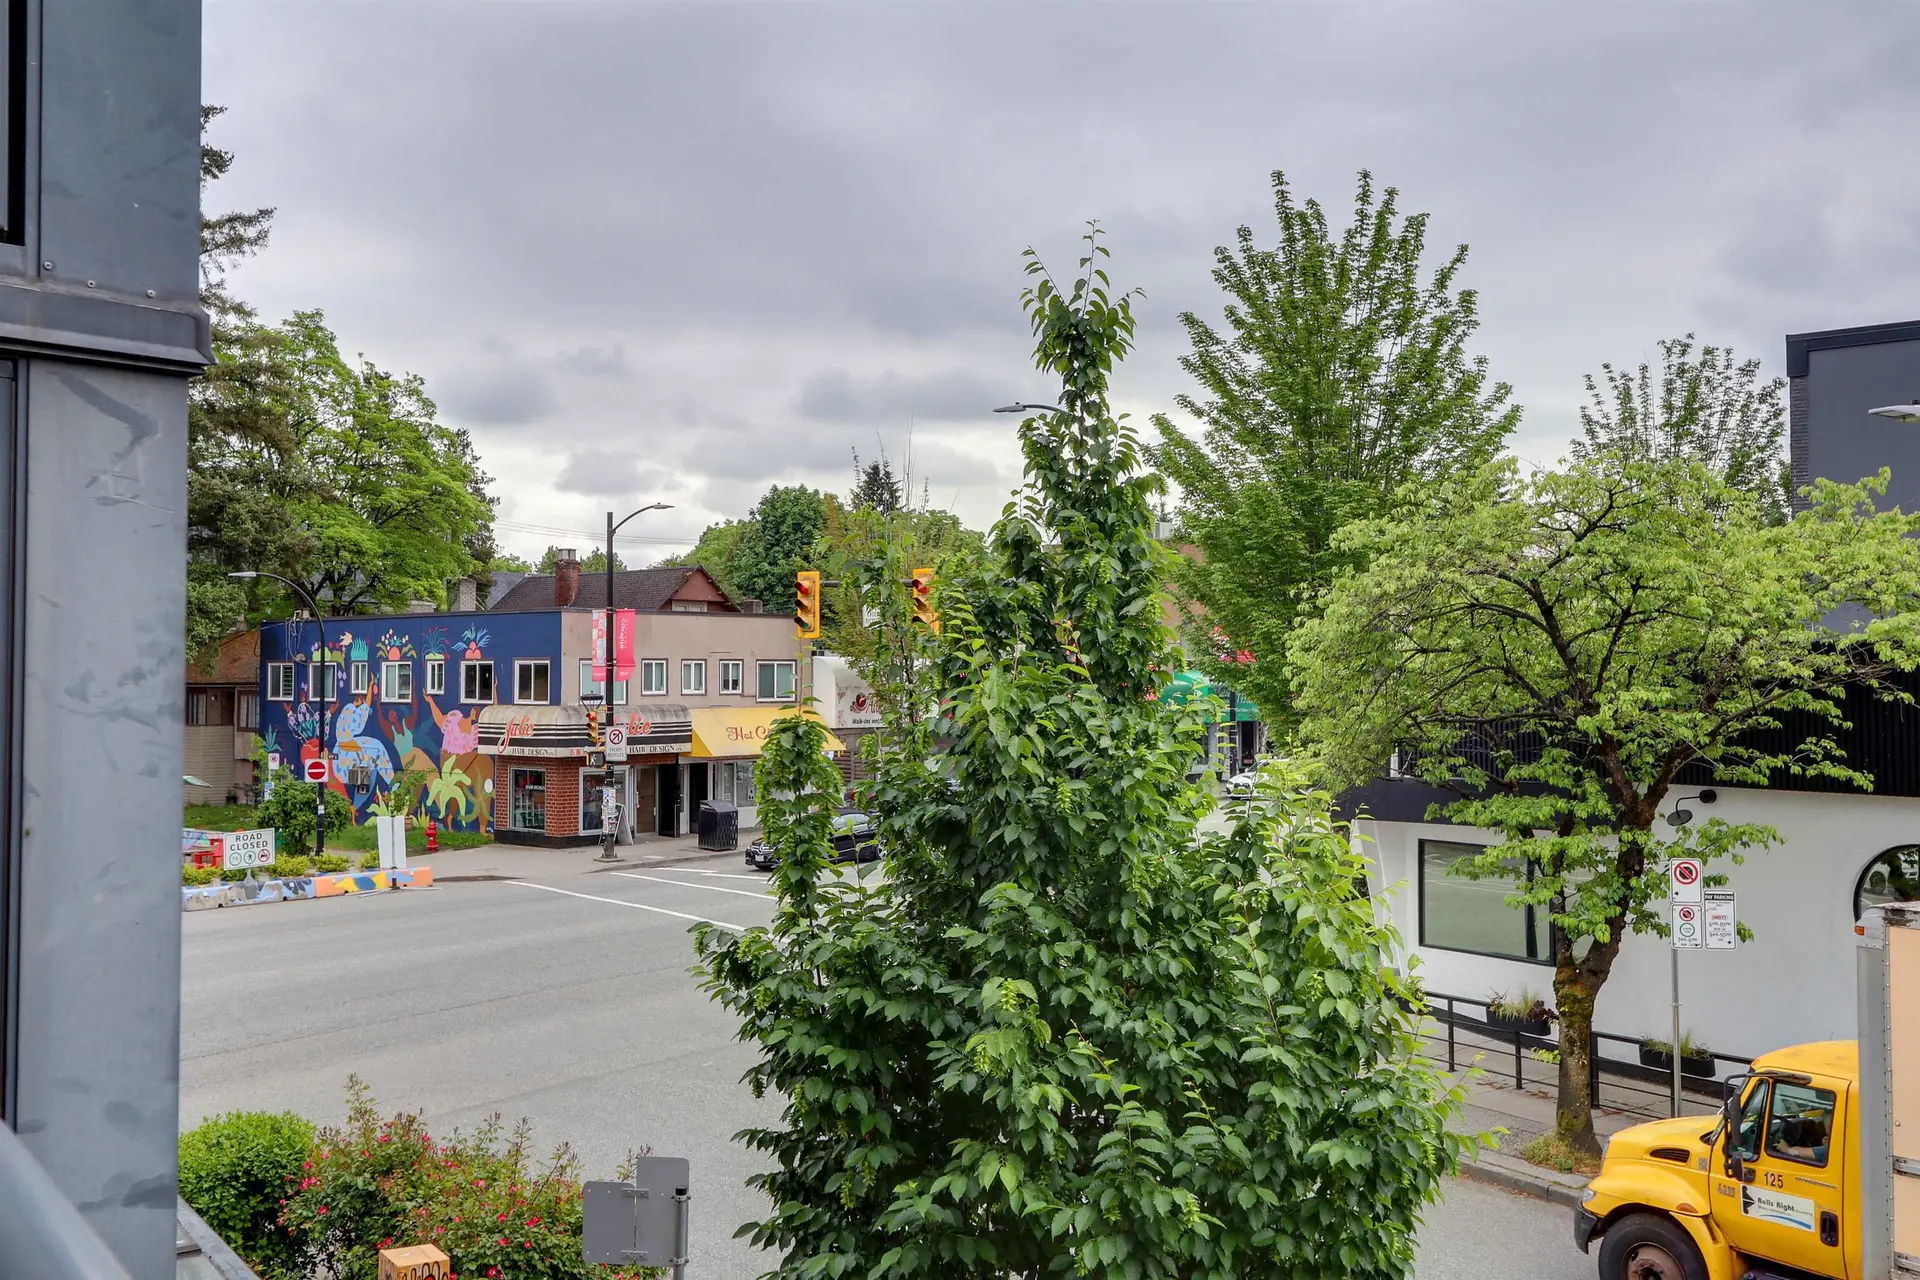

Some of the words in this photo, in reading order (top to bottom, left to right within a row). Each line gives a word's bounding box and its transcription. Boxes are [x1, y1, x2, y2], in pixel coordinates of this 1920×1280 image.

[497, 713, 535, 754] Julie
[726, 726, 754, 741] Hot
[527, 748, 549, 756] DESIGN
[649, 745, 675, 753] DESIGN
[235, 832, 262, 842] ROAD
[230, 840, 268, 851] CLOSED
[1764, 1172, 1784, 1188] 125
[1757, 1197, 1774, 1207] Rolls
[1776, 1201, 1795, 1212] Right
